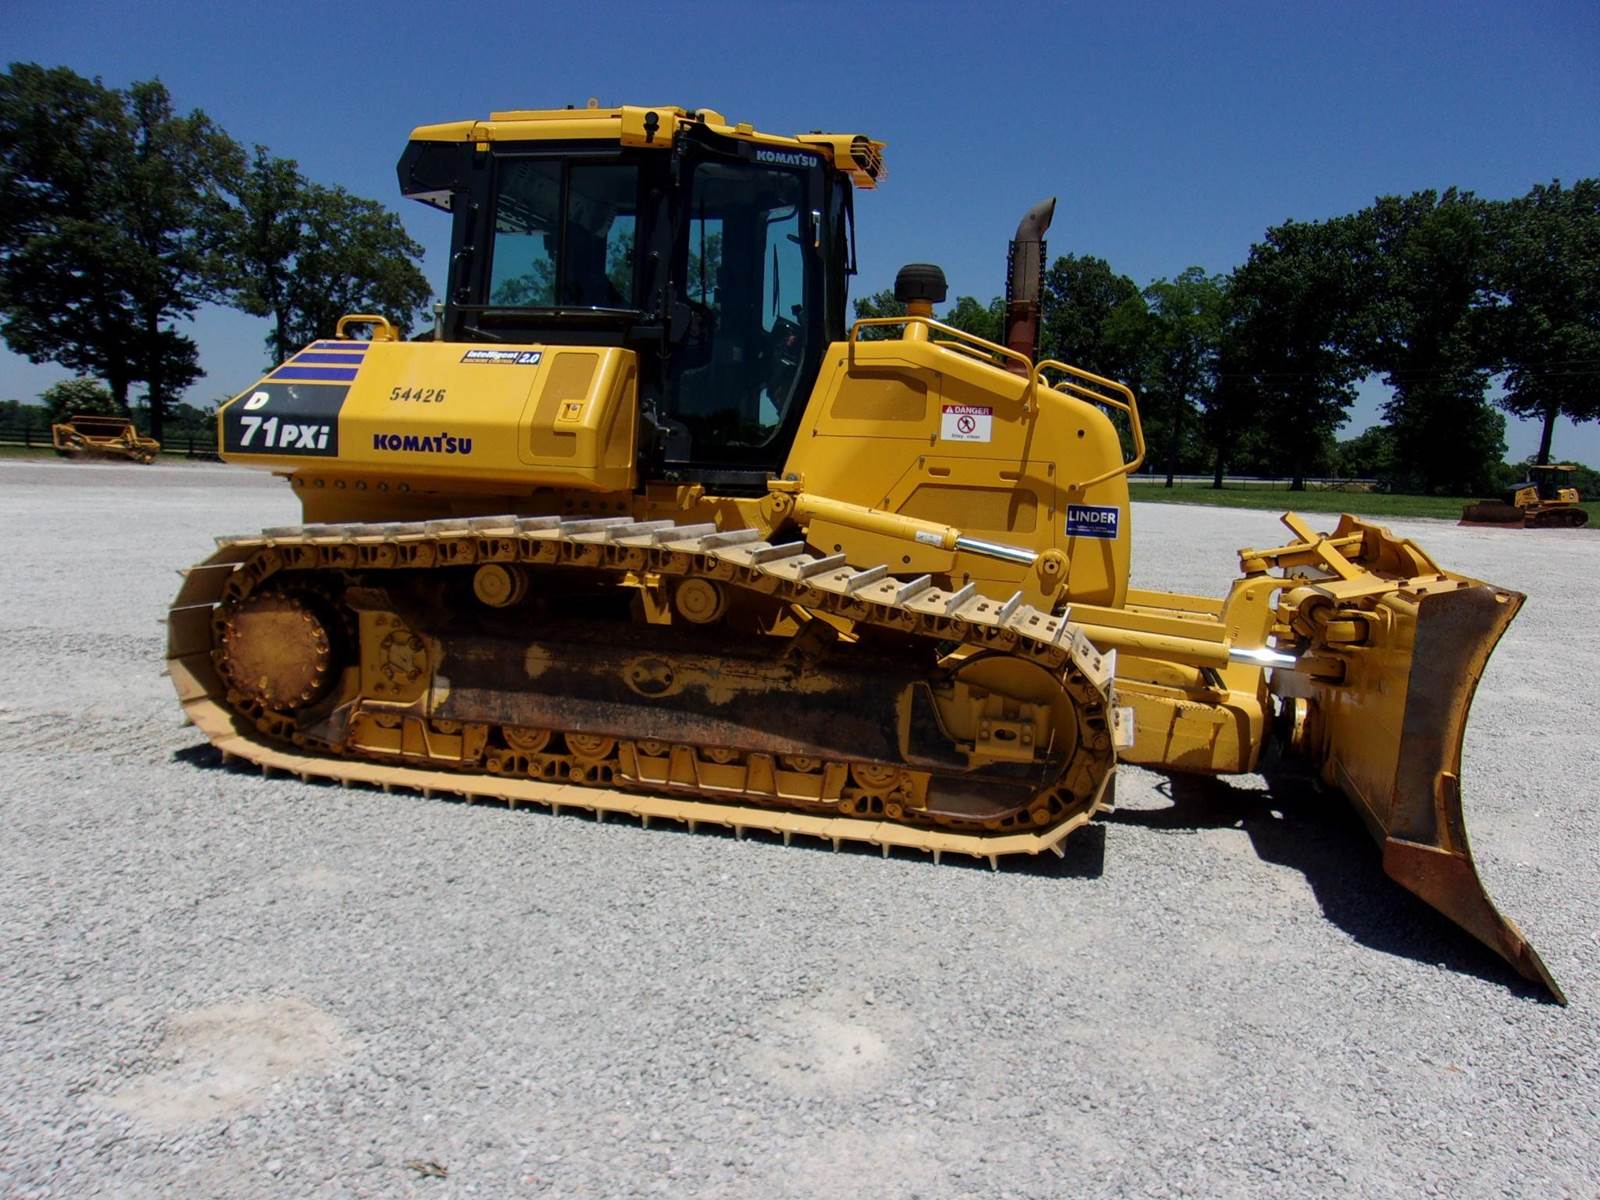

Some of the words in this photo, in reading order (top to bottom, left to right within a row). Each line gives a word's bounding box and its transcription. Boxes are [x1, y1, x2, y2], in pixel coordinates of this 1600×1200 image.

[756, 150, 817, 168] KOMATSU
[518, 353, 540, 364] 2.0
[243, 391, 270, 410] D
[389, 387, 446, 403] 54426
[954, 406, 990, 415] DANGER
[373, 432, 472, 455] KOMATSU
[1068, 510, 1116, 524] LINDER
